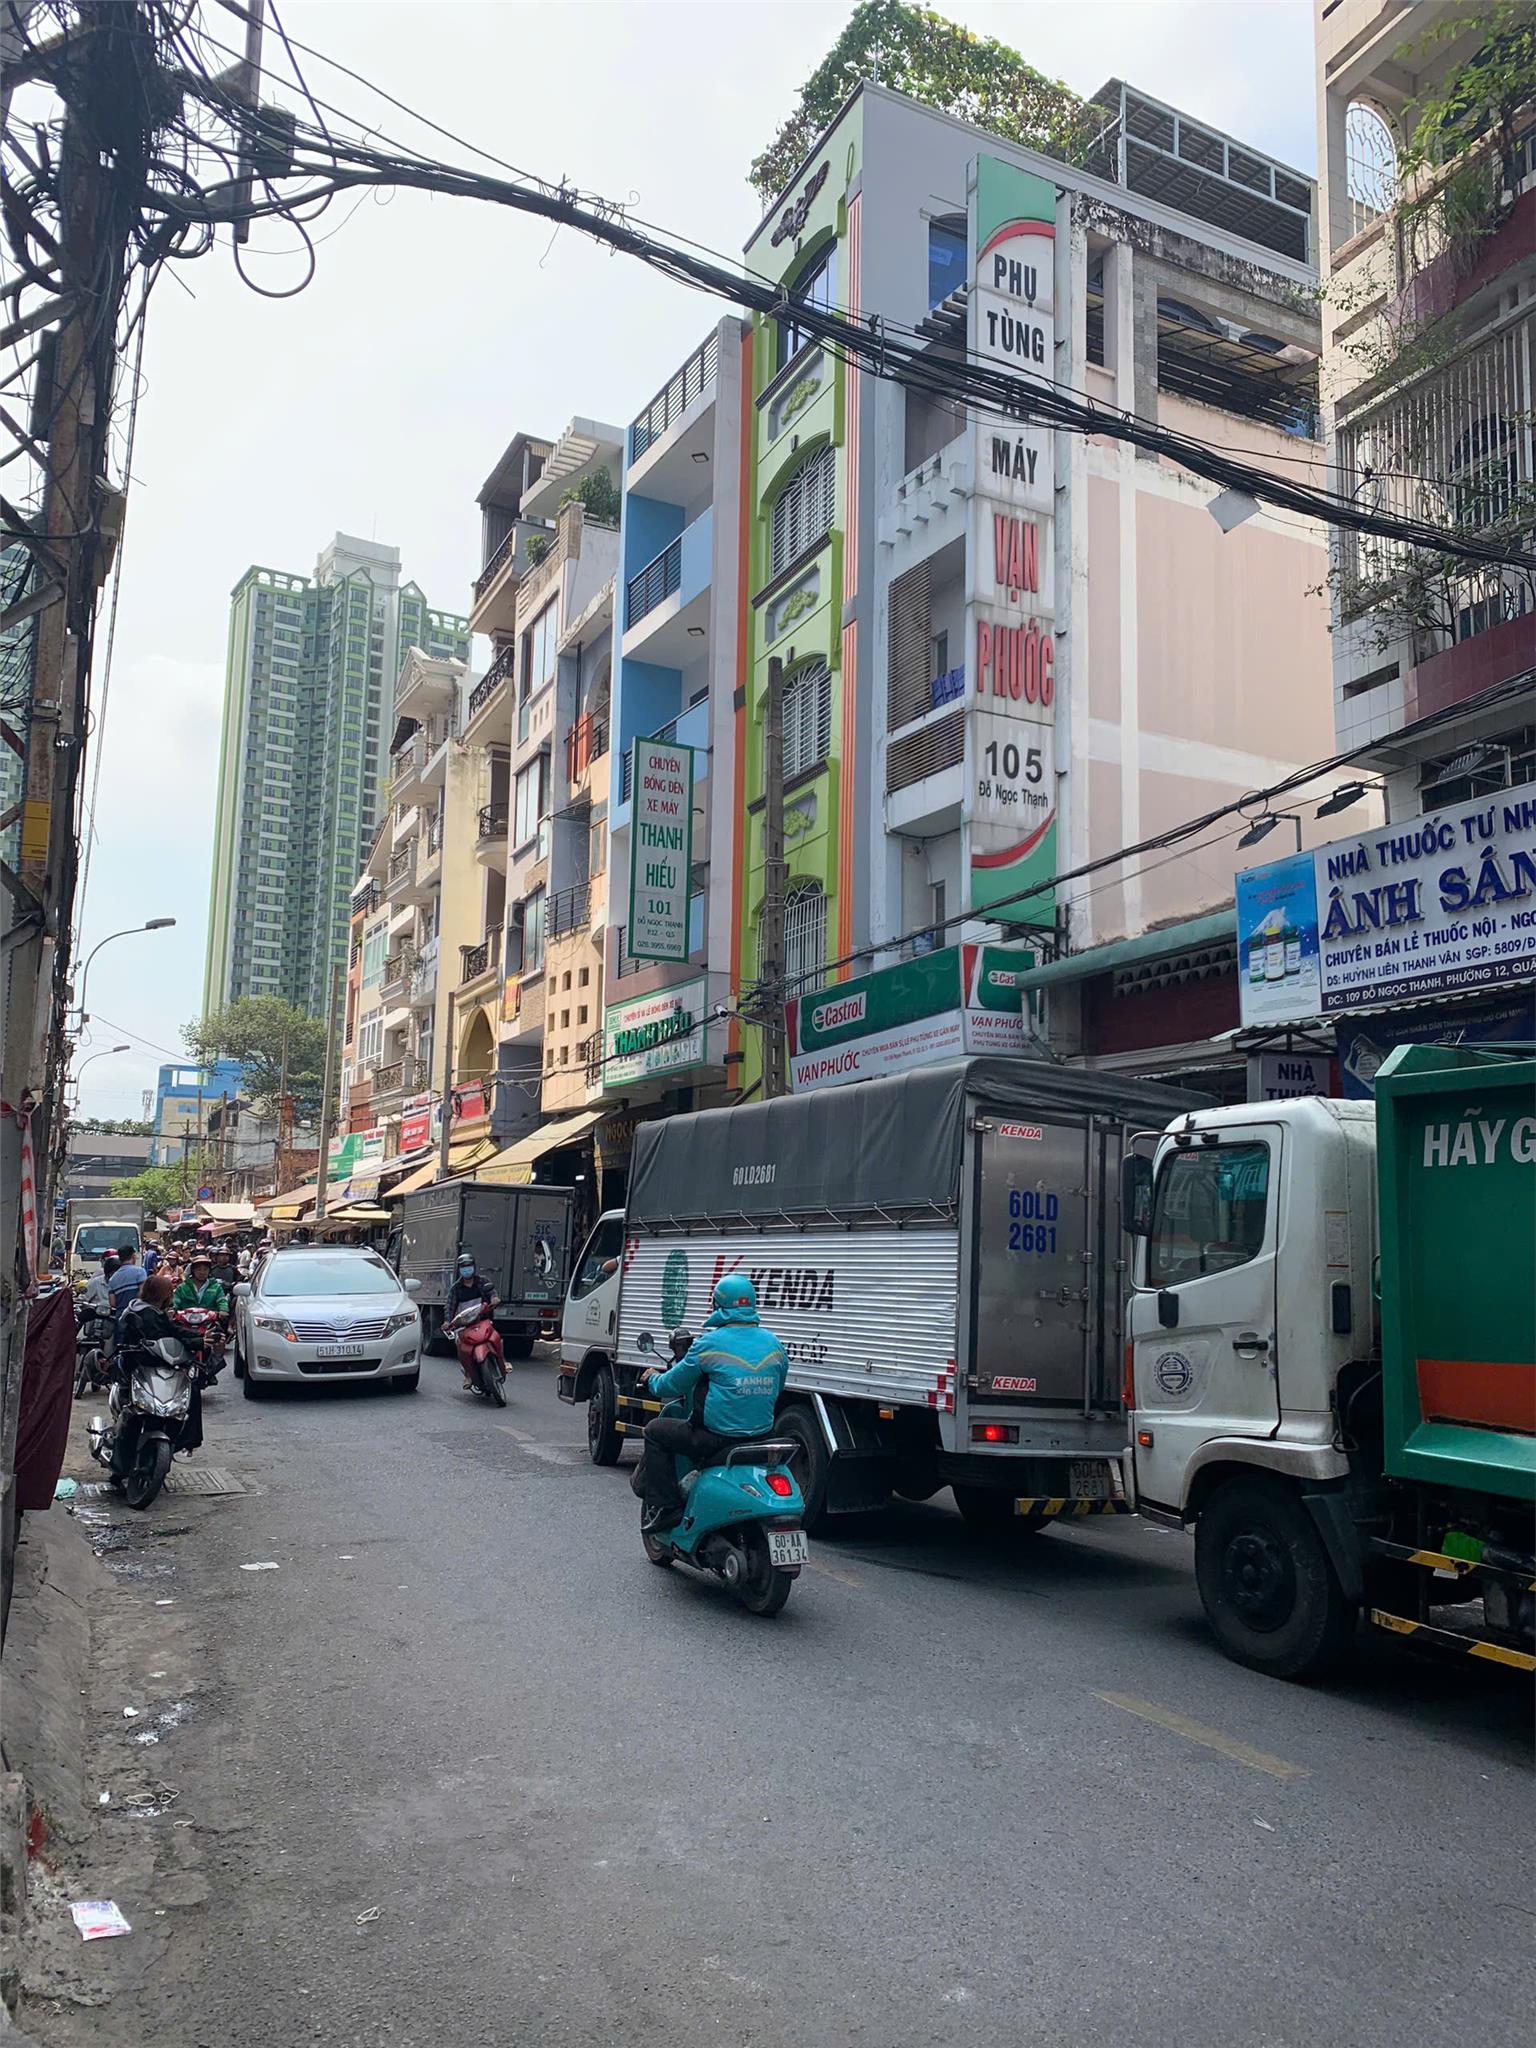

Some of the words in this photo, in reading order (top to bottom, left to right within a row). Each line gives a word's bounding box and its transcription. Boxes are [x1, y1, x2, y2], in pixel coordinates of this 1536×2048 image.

[994, 253, 1037, 308] PHỤ
[987, 309, 1044, 364] TÙNG
[991, 438, 1038, 484] MÁY
[994, 513, 1039, 602] VẠN
[976, 618, 1054, 707] PHƯỚC
[649, 756, 681, 773] CHUYÊN
[985, 740, 1042, 784] 105
[643, 774, 666, 792] BÓNG
[978, 780, 991, 798] Đỗ
[995, 784, 1018, 805] Ngọc
[1022, 788, 1048, 808] Thạnh
[647, 798, 658, 812] XE
[661, 799, 679, 815] MÁY
[640, 822, 683, 851] THANH
[1328, 842, 1369, 881] NHÀ
[1376, 815, 1454, 866] THUỐC
[1461, 805, 1496, 844] TƯ
[646, 856, 676, 889] HIẾU
[648, 899, 672, 915] 101
[1321, 878, 1422, 940] ÁNH
[1325, 944, 1371, 968] CHUYÊN
[1375, 938, 1400, 957] BÁN
[1404, 930, 1419, 952] LẺ
[1423, 921, 1468, 947] THUỐC
[1472, 917, 1496, 938] NỘI
[1327, 975, 1341, 986] DS:
[1343, 967, 1376, 983] HUỲNH
[1378, 961, 1399, 977] LIÊN
[1403, 956, 1436, 972] THANH
[1439, 950, 1460, 965] VÂN
[1466, 946, 1492, 960] SGP:
[1328, 995, 1344, 1006] ĐC:
[1346, 991, 1360, 1003] 109
[1362, 985, 1376, 1000] ĐỖ
[1378, 983, 1407, 997] NGỌC
[1446, 968, 1491, 985] PHƯỜNG
[1495, 965, 1510, 977] 12,
[825, 996, 863, 1027] Castrol
[971, 1016, 993, 1029] VẠN
[797, 1062, 819, 1086] VẠN
[820, 1050, 860, 1078] PHƯỚC
[1278, 1060, 1314, 1081] NHÀ
[1000, 1125, 1042, 1139] KENDA
[1423, 1107, 1506, 1168] HÃY
[733, 1164, 776, 1185] 60LD2681
[1009, 1190, 1058, 1221] 60LD
[1008, 1222, 1057, 1253] 2681
[750, 1268, 835, 1312] KENDA
[800, 1333, 828, 1365] CẤP
[993, 1377, 1036, 1390] KENDA
